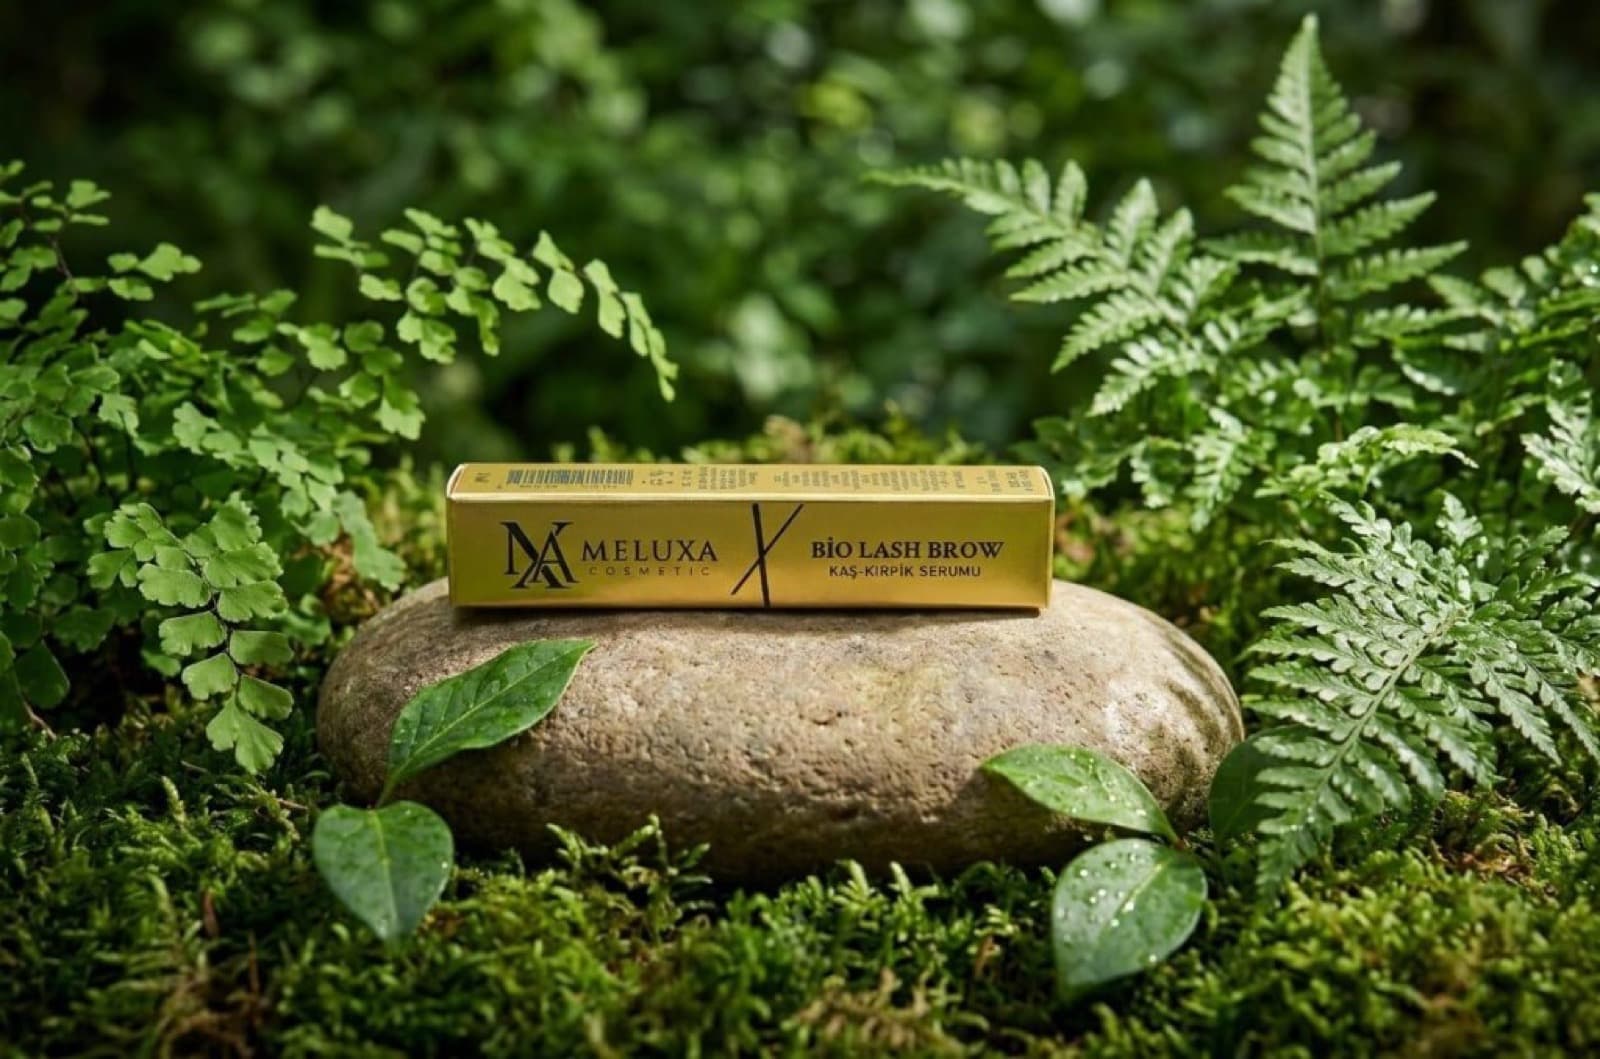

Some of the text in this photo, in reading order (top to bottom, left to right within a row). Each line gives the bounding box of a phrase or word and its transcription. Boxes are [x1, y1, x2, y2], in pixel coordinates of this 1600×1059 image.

[581, 540, 718, 562] MELUXA
[859, 541, 921, 559] LASH
[927, 541, 1005, 559] BROW
[588, 566, 710, 576] COSMETIC
[919, 565, 981, 577] SERUMU
